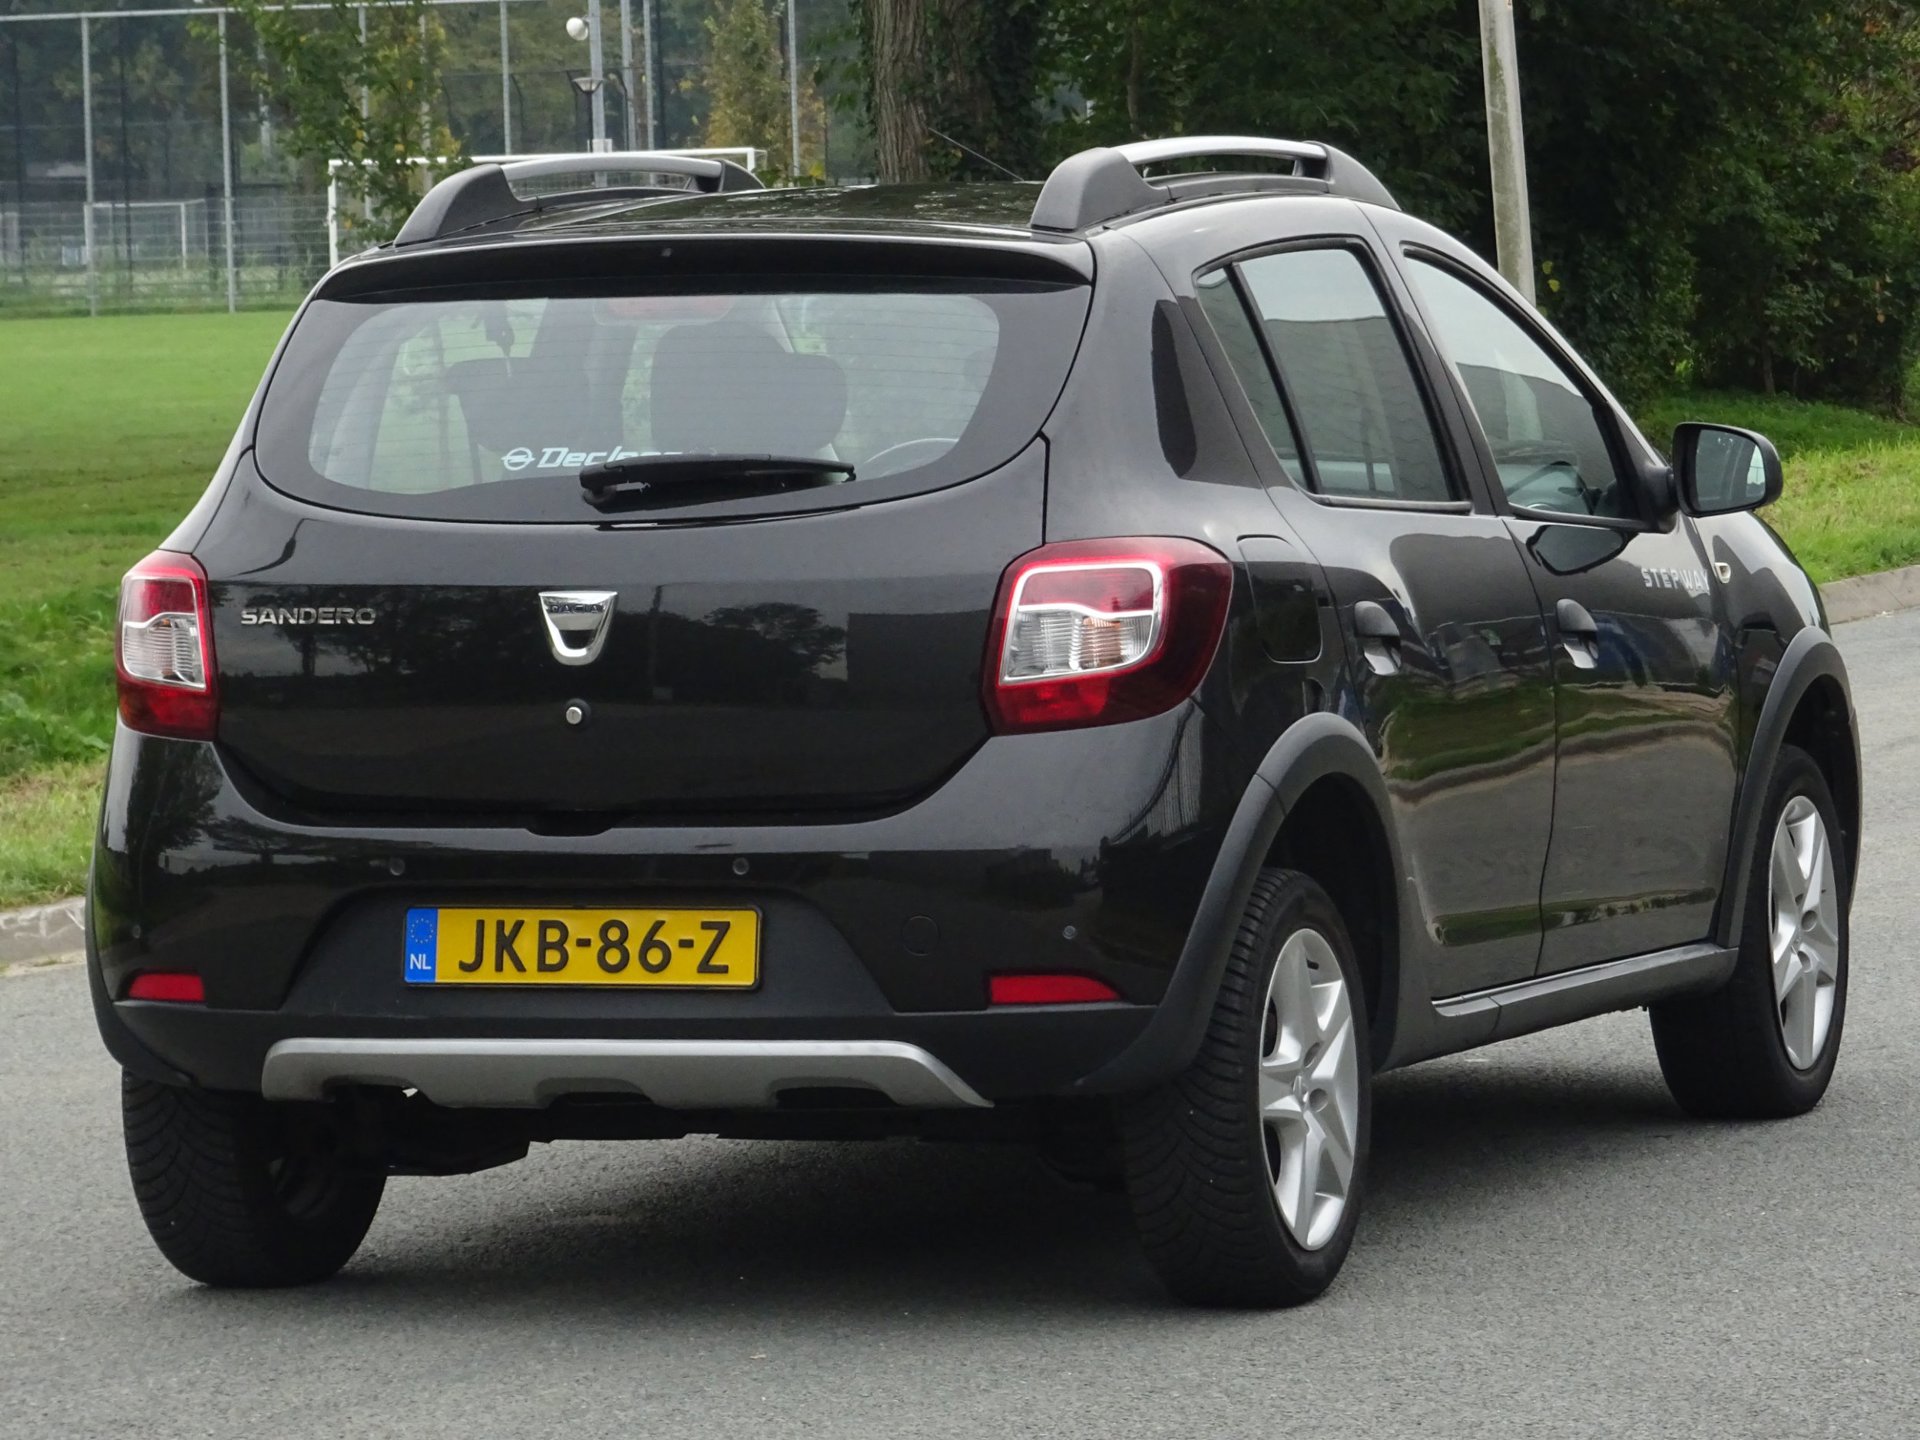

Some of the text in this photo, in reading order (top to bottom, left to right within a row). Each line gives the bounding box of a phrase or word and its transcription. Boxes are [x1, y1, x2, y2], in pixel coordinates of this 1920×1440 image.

[1641, 567, 1710, 591] STEPWAY
[240, 607, 376, 625] SANDERO
[458, 919, 731, 974] JKB-86-Z
[410, 953, 431, 970] NL
